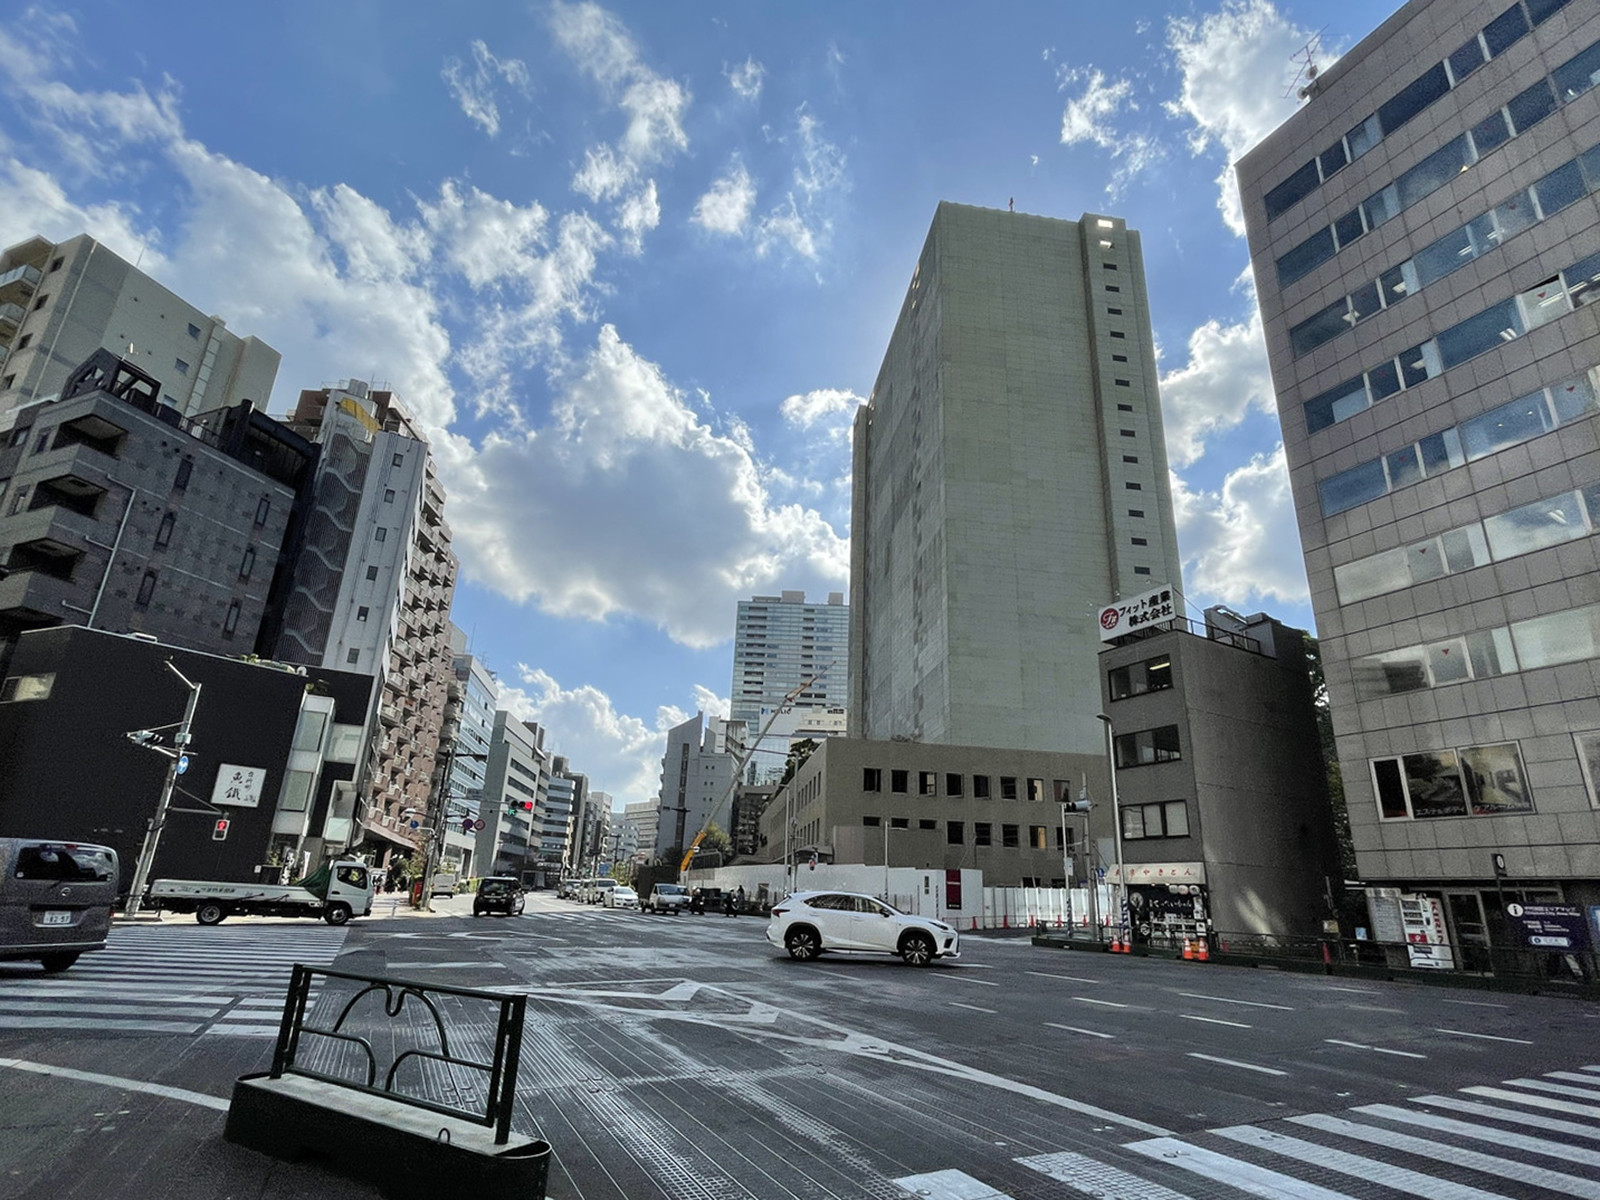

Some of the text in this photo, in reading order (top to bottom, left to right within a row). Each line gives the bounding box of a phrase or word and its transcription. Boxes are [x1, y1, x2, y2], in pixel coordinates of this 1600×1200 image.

[1129, 603, 1173, 627] 株式会社
[1431, 901, 1444, 943] KIRIN
